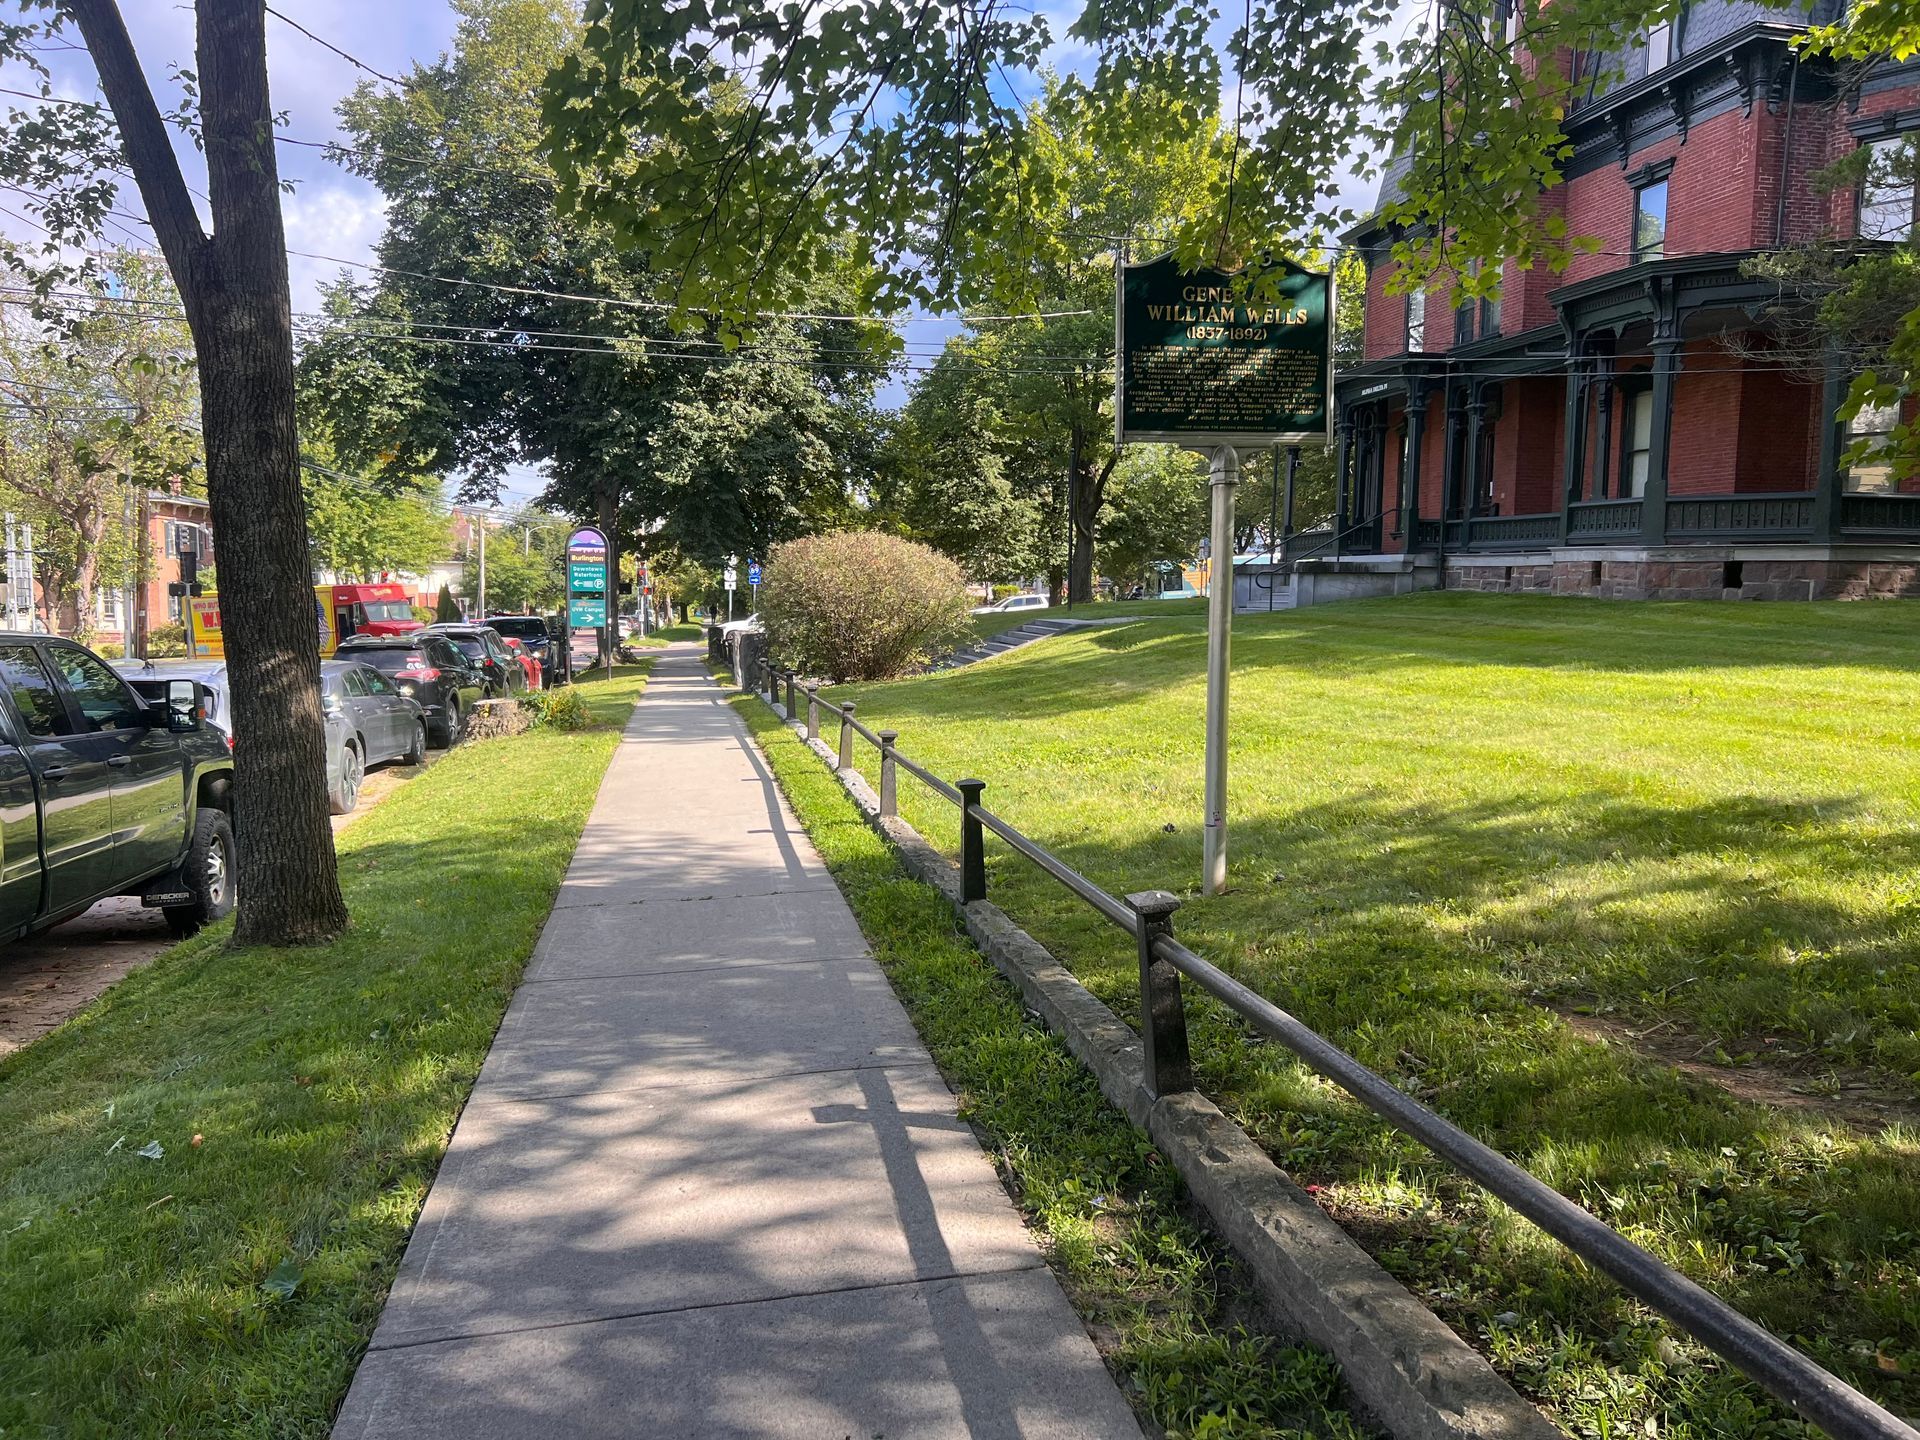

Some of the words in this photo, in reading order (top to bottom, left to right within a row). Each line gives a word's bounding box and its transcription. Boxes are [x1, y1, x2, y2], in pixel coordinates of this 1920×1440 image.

[1183, 286, 1271, 304] GENEAL
[1147, 305, 1235, 323] WILLIAM
[1247, 308, 1308, 325] WELLS
[1186, 326, 1267, 340] (1837-1892)
[146, 892, 189, 900] DENECKER
